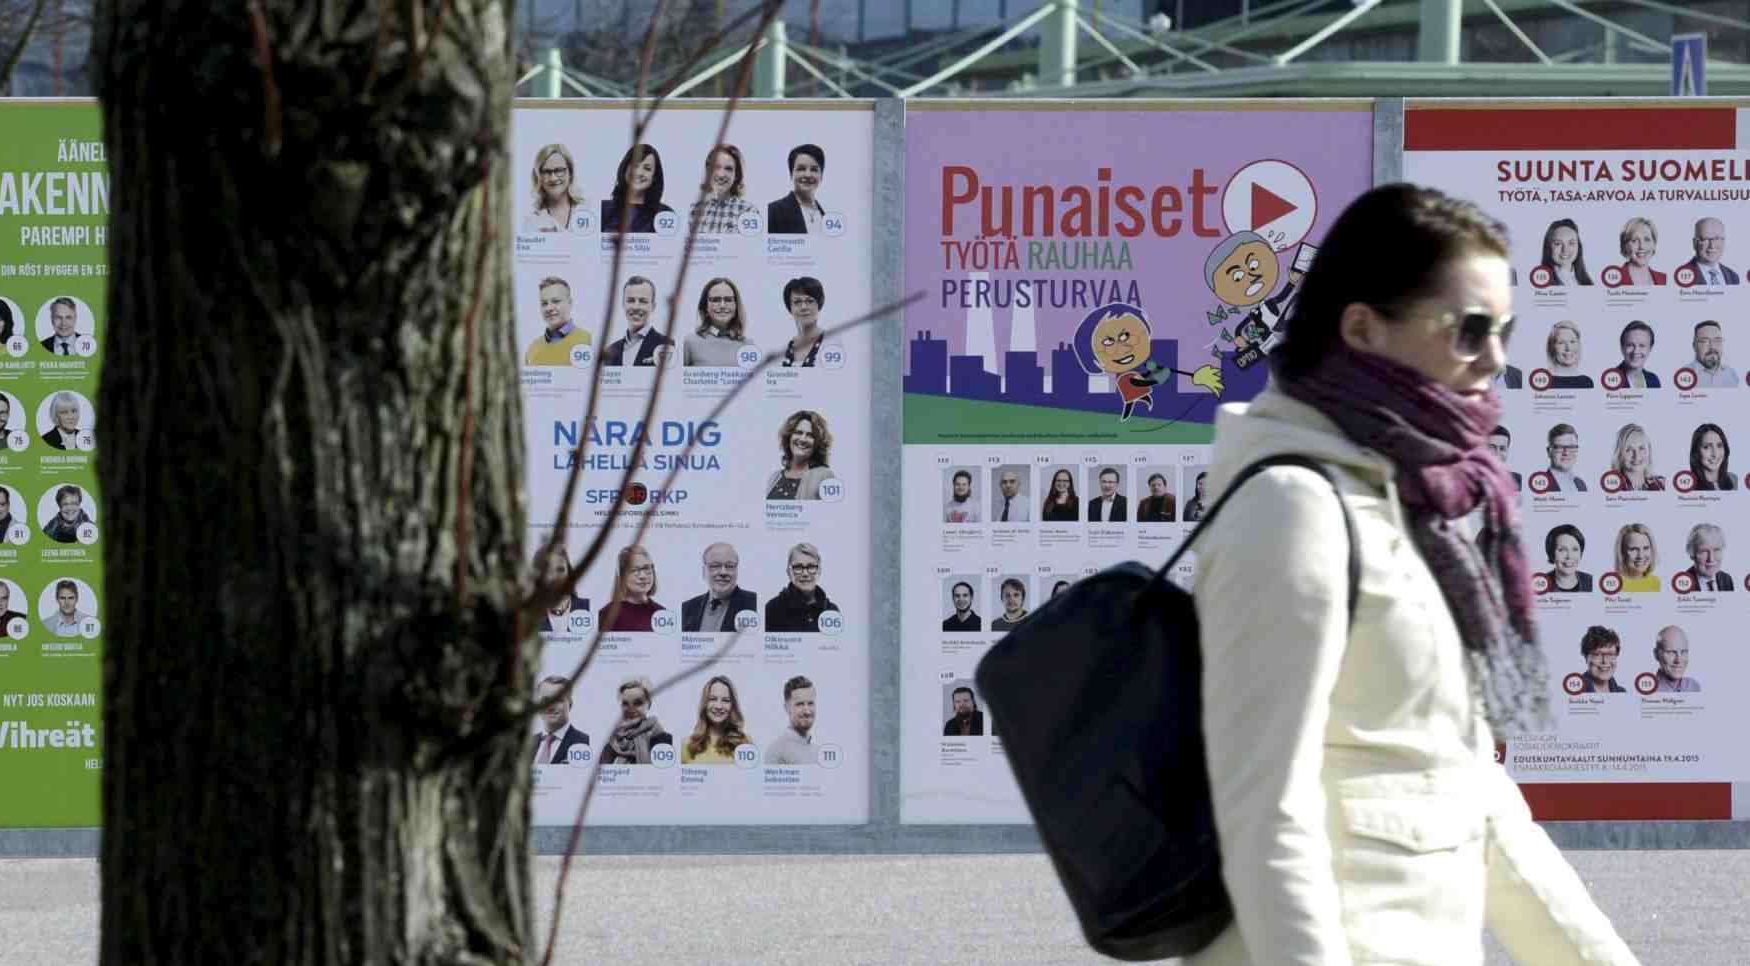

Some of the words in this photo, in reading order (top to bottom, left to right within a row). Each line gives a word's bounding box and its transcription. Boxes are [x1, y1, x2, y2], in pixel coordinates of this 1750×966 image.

[1498, 160, 1613, 182] SUUNTA
[1498, 188, 1548, 203] TYÖTÄ,
[1551, 190, 1635, 201] TASA-ARVOA
[1641, 190, 1654, 200] JA
[942, 166, 1223, 237] Punaiset
[577, 218, 589, 228] 91
[659, 218, 674, 229] 92
[743, 219, 758, 229] 93
[825, 220, 841, 230] 94
[21, 226, 90, 245] PAREMPI
[941, 235, 1020, 271] TYÖTÄ
[1029, 241, 1133, 270] RAUHAA
[942, 280, 1142, 308] PERUSTURVAA
[575, 352, 590, 362] 96
[741, 352, 758, 362] 98
[824, 352, 841, 362] 99
[662, 421, 721, 446] DIG
[654, 454, 720, 470] SINUA
[824, 486, 840, 495] 101
[650, 490, 687, 503] RKP
[570, 618, 590, 627] 103
[653, 617, 674, 627] 104
[737, 617, 758, 627] 105
[820, 618, 841, 628] 106
[3, 694, 23, 706] NYT
[27, 694, 43, 707] JOS
[47, 694, 95, 706] KOSKAAN
[570, 751, 590, 761] 108
[653, 751, 674, 761] 109
[738, 751, 754, 761] 110
[824, 752, 836, 761] 111
[1514, 755, 1594, 763] EDUSKUNTAVAALIT
